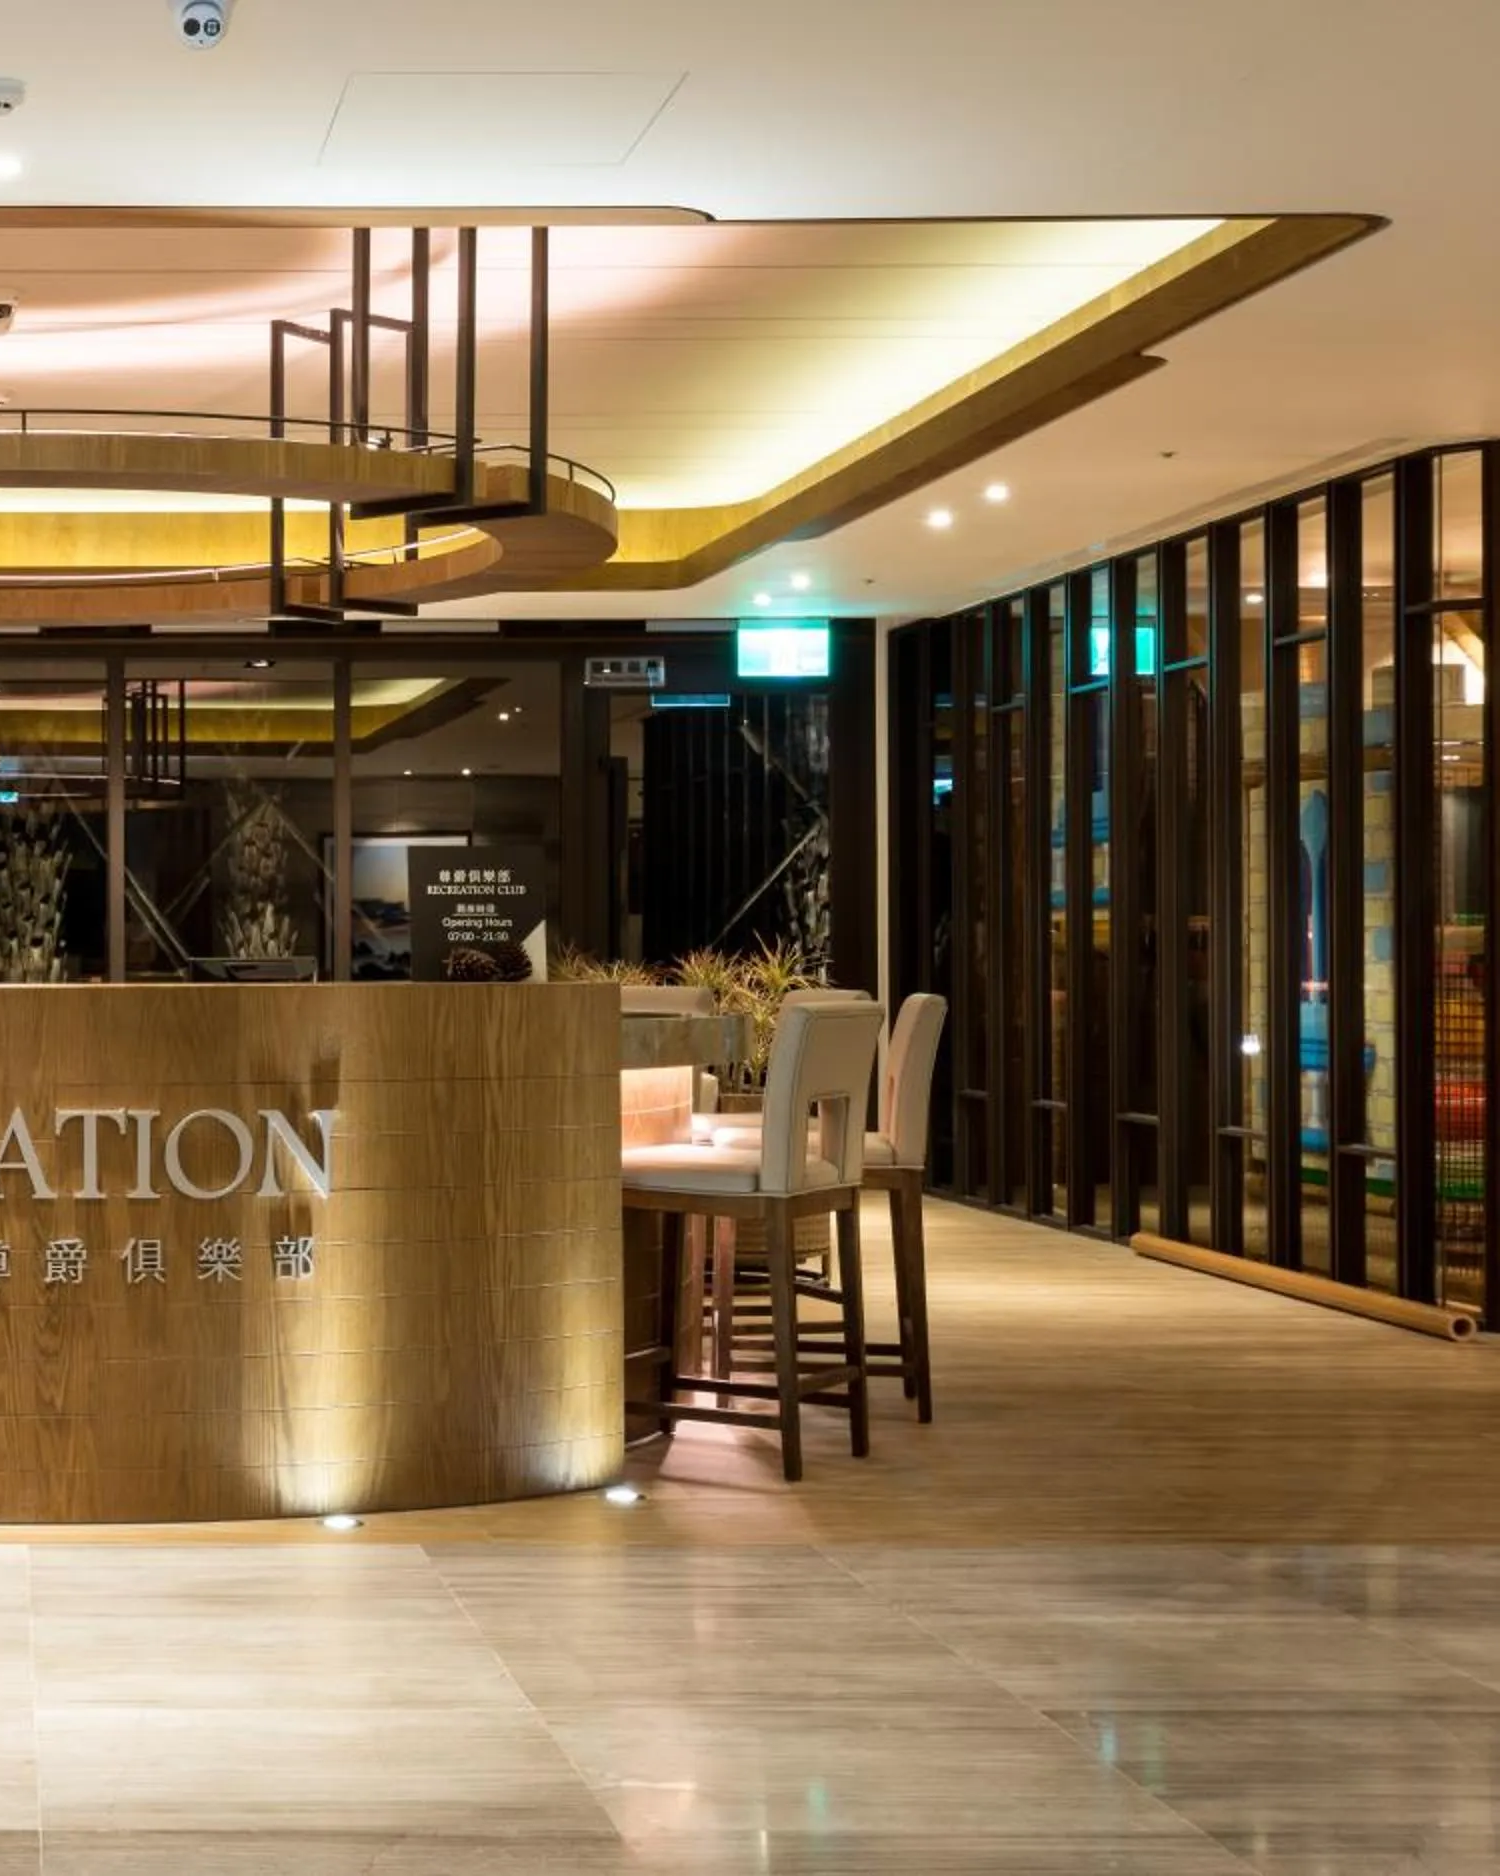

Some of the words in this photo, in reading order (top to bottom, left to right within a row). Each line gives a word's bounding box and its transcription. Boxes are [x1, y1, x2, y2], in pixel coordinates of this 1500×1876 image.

[427, 885, 495, 895] RECREATION
[497, 885, 527, 895] CLUB
[442, 917, 483, 928] Opening
[485, 917, 513, 927] Hours
[447, 931, 475, 941] 07:00
